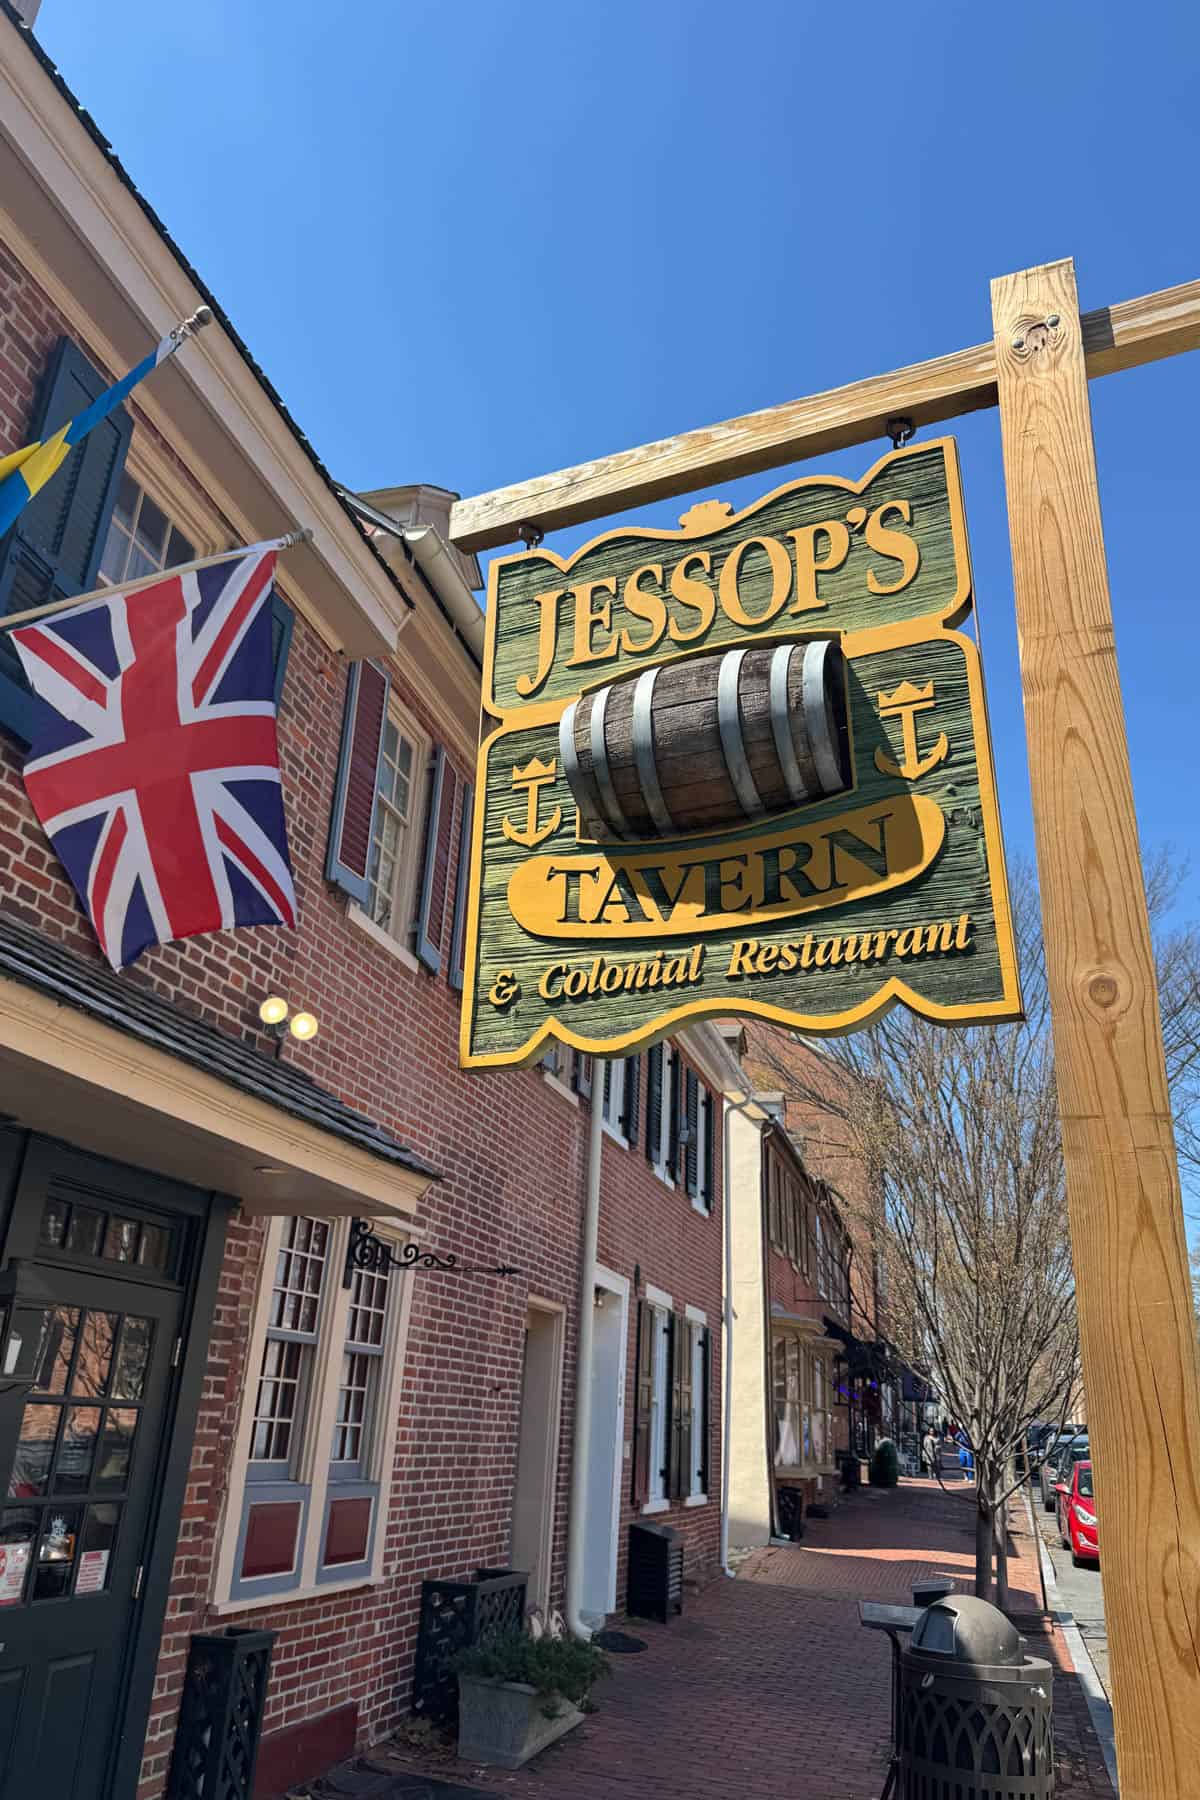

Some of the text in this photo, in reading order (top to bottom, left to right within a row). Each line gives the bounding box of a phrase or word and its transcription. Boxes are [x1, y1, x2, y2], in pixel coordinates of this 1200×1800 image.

[516, 499, 919, 697] JESSOP'S
[547, 815, 893, 925] TAVERN
[488, 914, 972, 1005] & Colonial Restaurant
